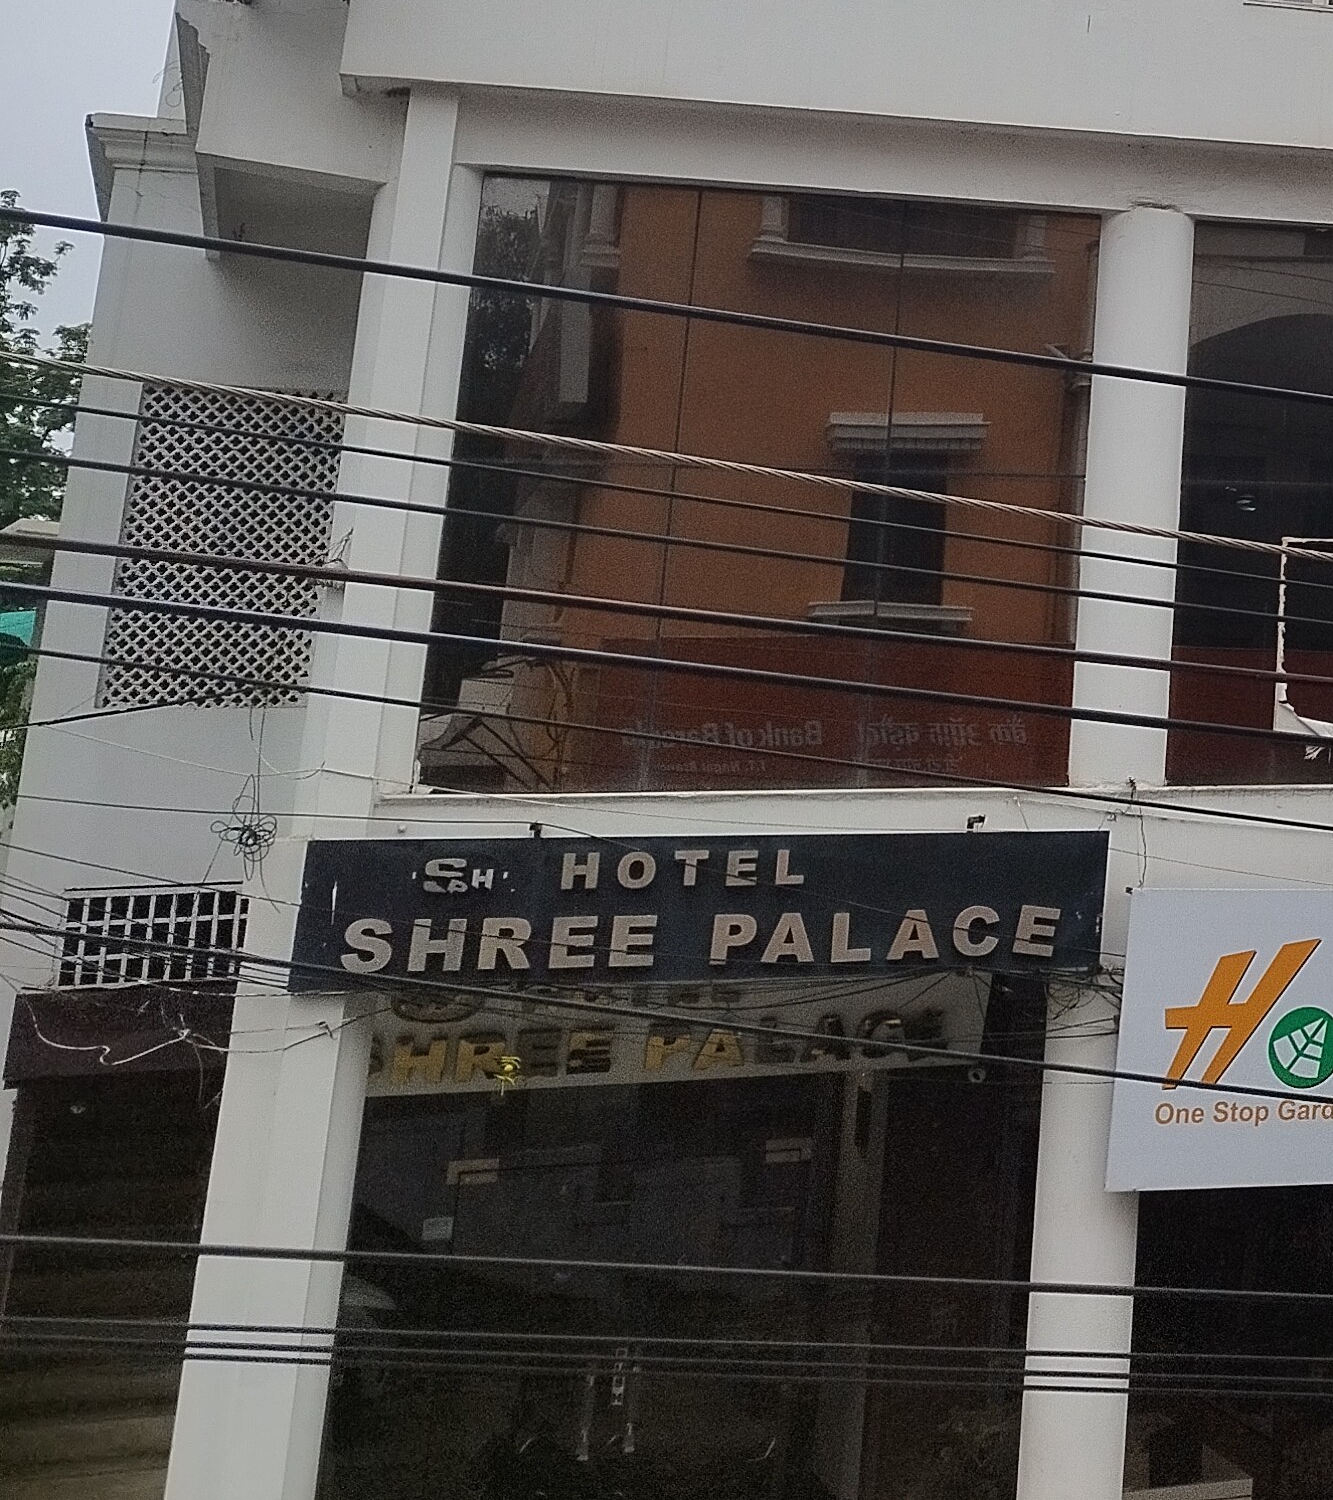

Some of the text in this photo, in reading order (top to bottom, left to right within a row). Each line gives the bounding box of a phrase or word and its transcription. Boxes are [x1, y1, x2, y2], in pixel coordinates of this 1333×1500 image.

[560, 848, 806, 892] HOTEL
[341, 904, 1061, 974] SHREE PALACE
[1155, 1102, 1204, 1125] One
[1213, 1100, 1269, 1127] Stop
